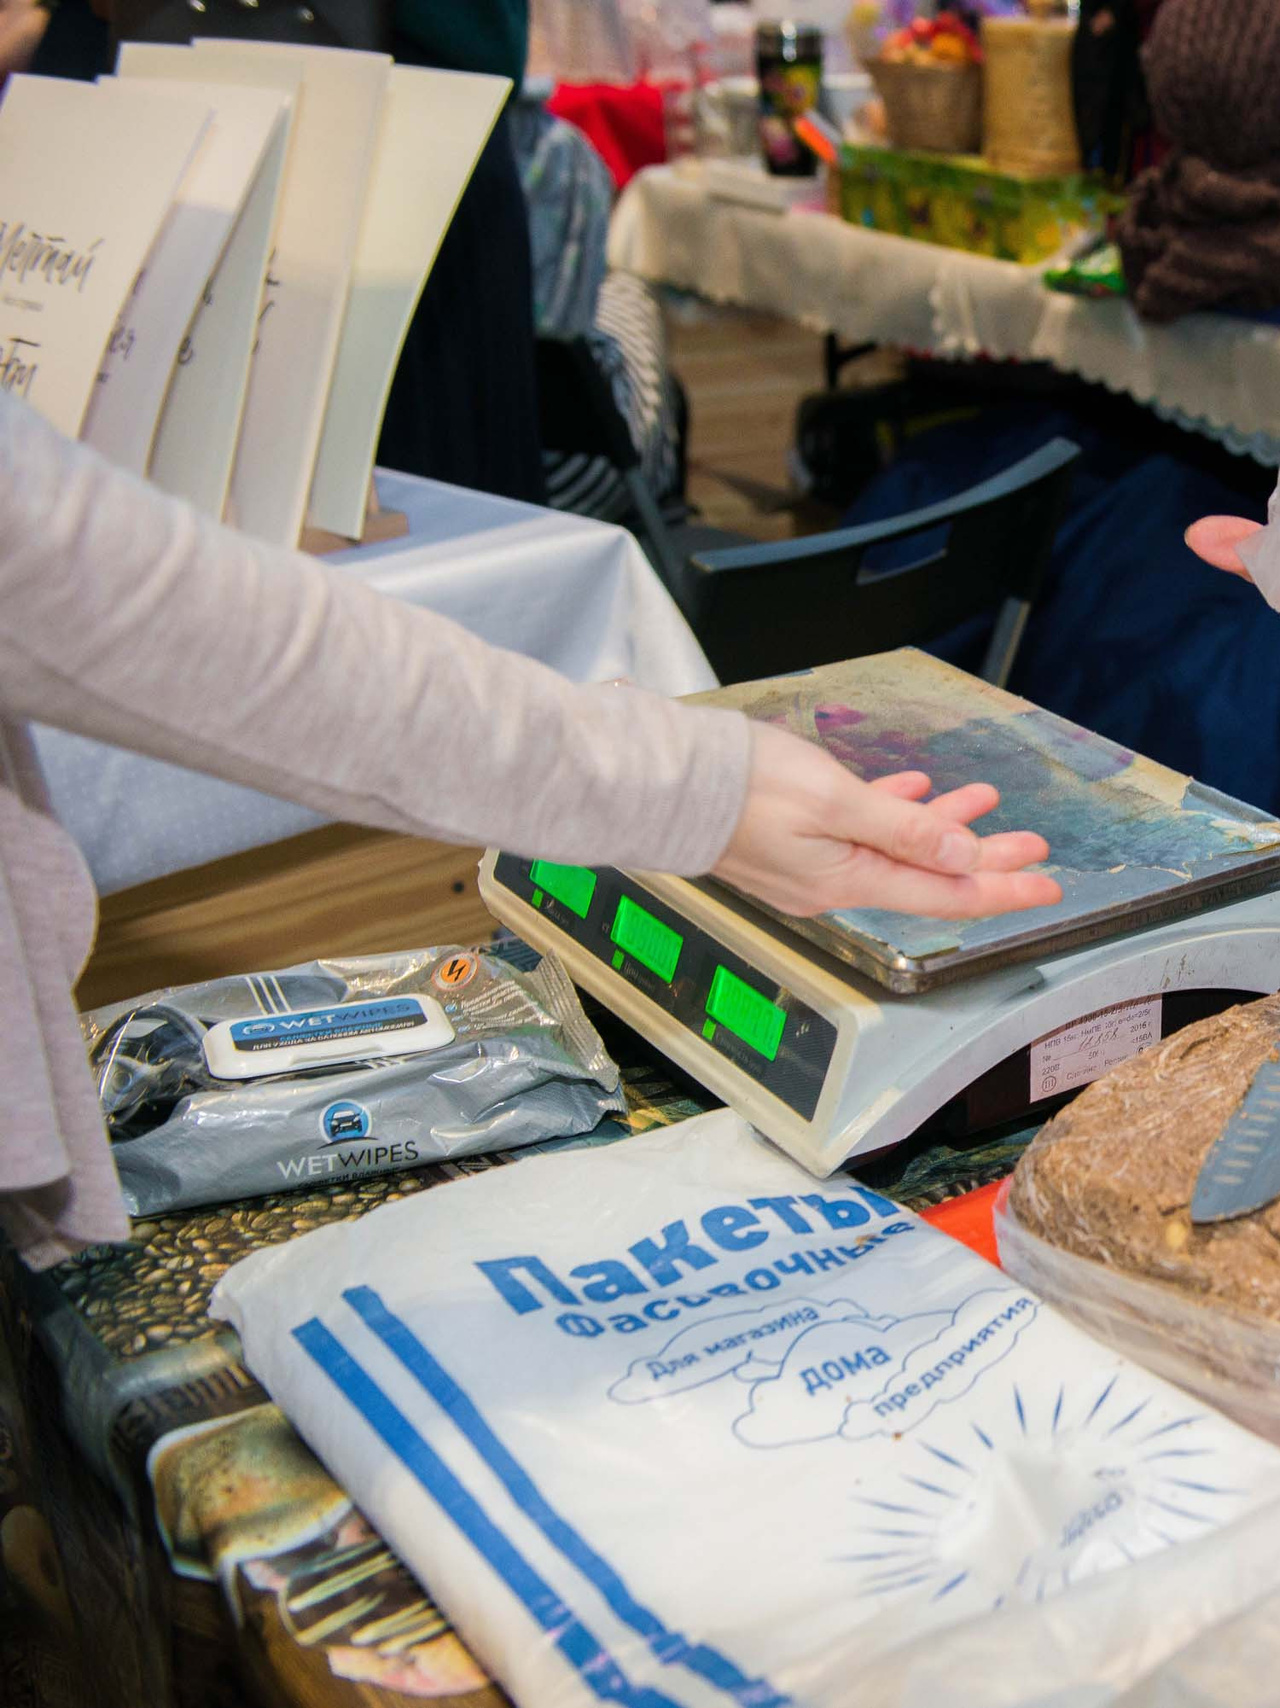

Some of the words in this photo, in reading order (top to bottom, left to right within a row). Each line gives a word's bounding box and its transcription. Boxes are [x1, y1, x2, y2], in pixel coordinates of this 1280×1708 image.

[474, 1186, 900, 1316] Пакеты
[646, 1349, 699, 1382] Для
[703, 1305, 821, 1358] магазина
[799, 1345, 892, 1396] дома
[873, 1296, 1034, 1418] предприятия
